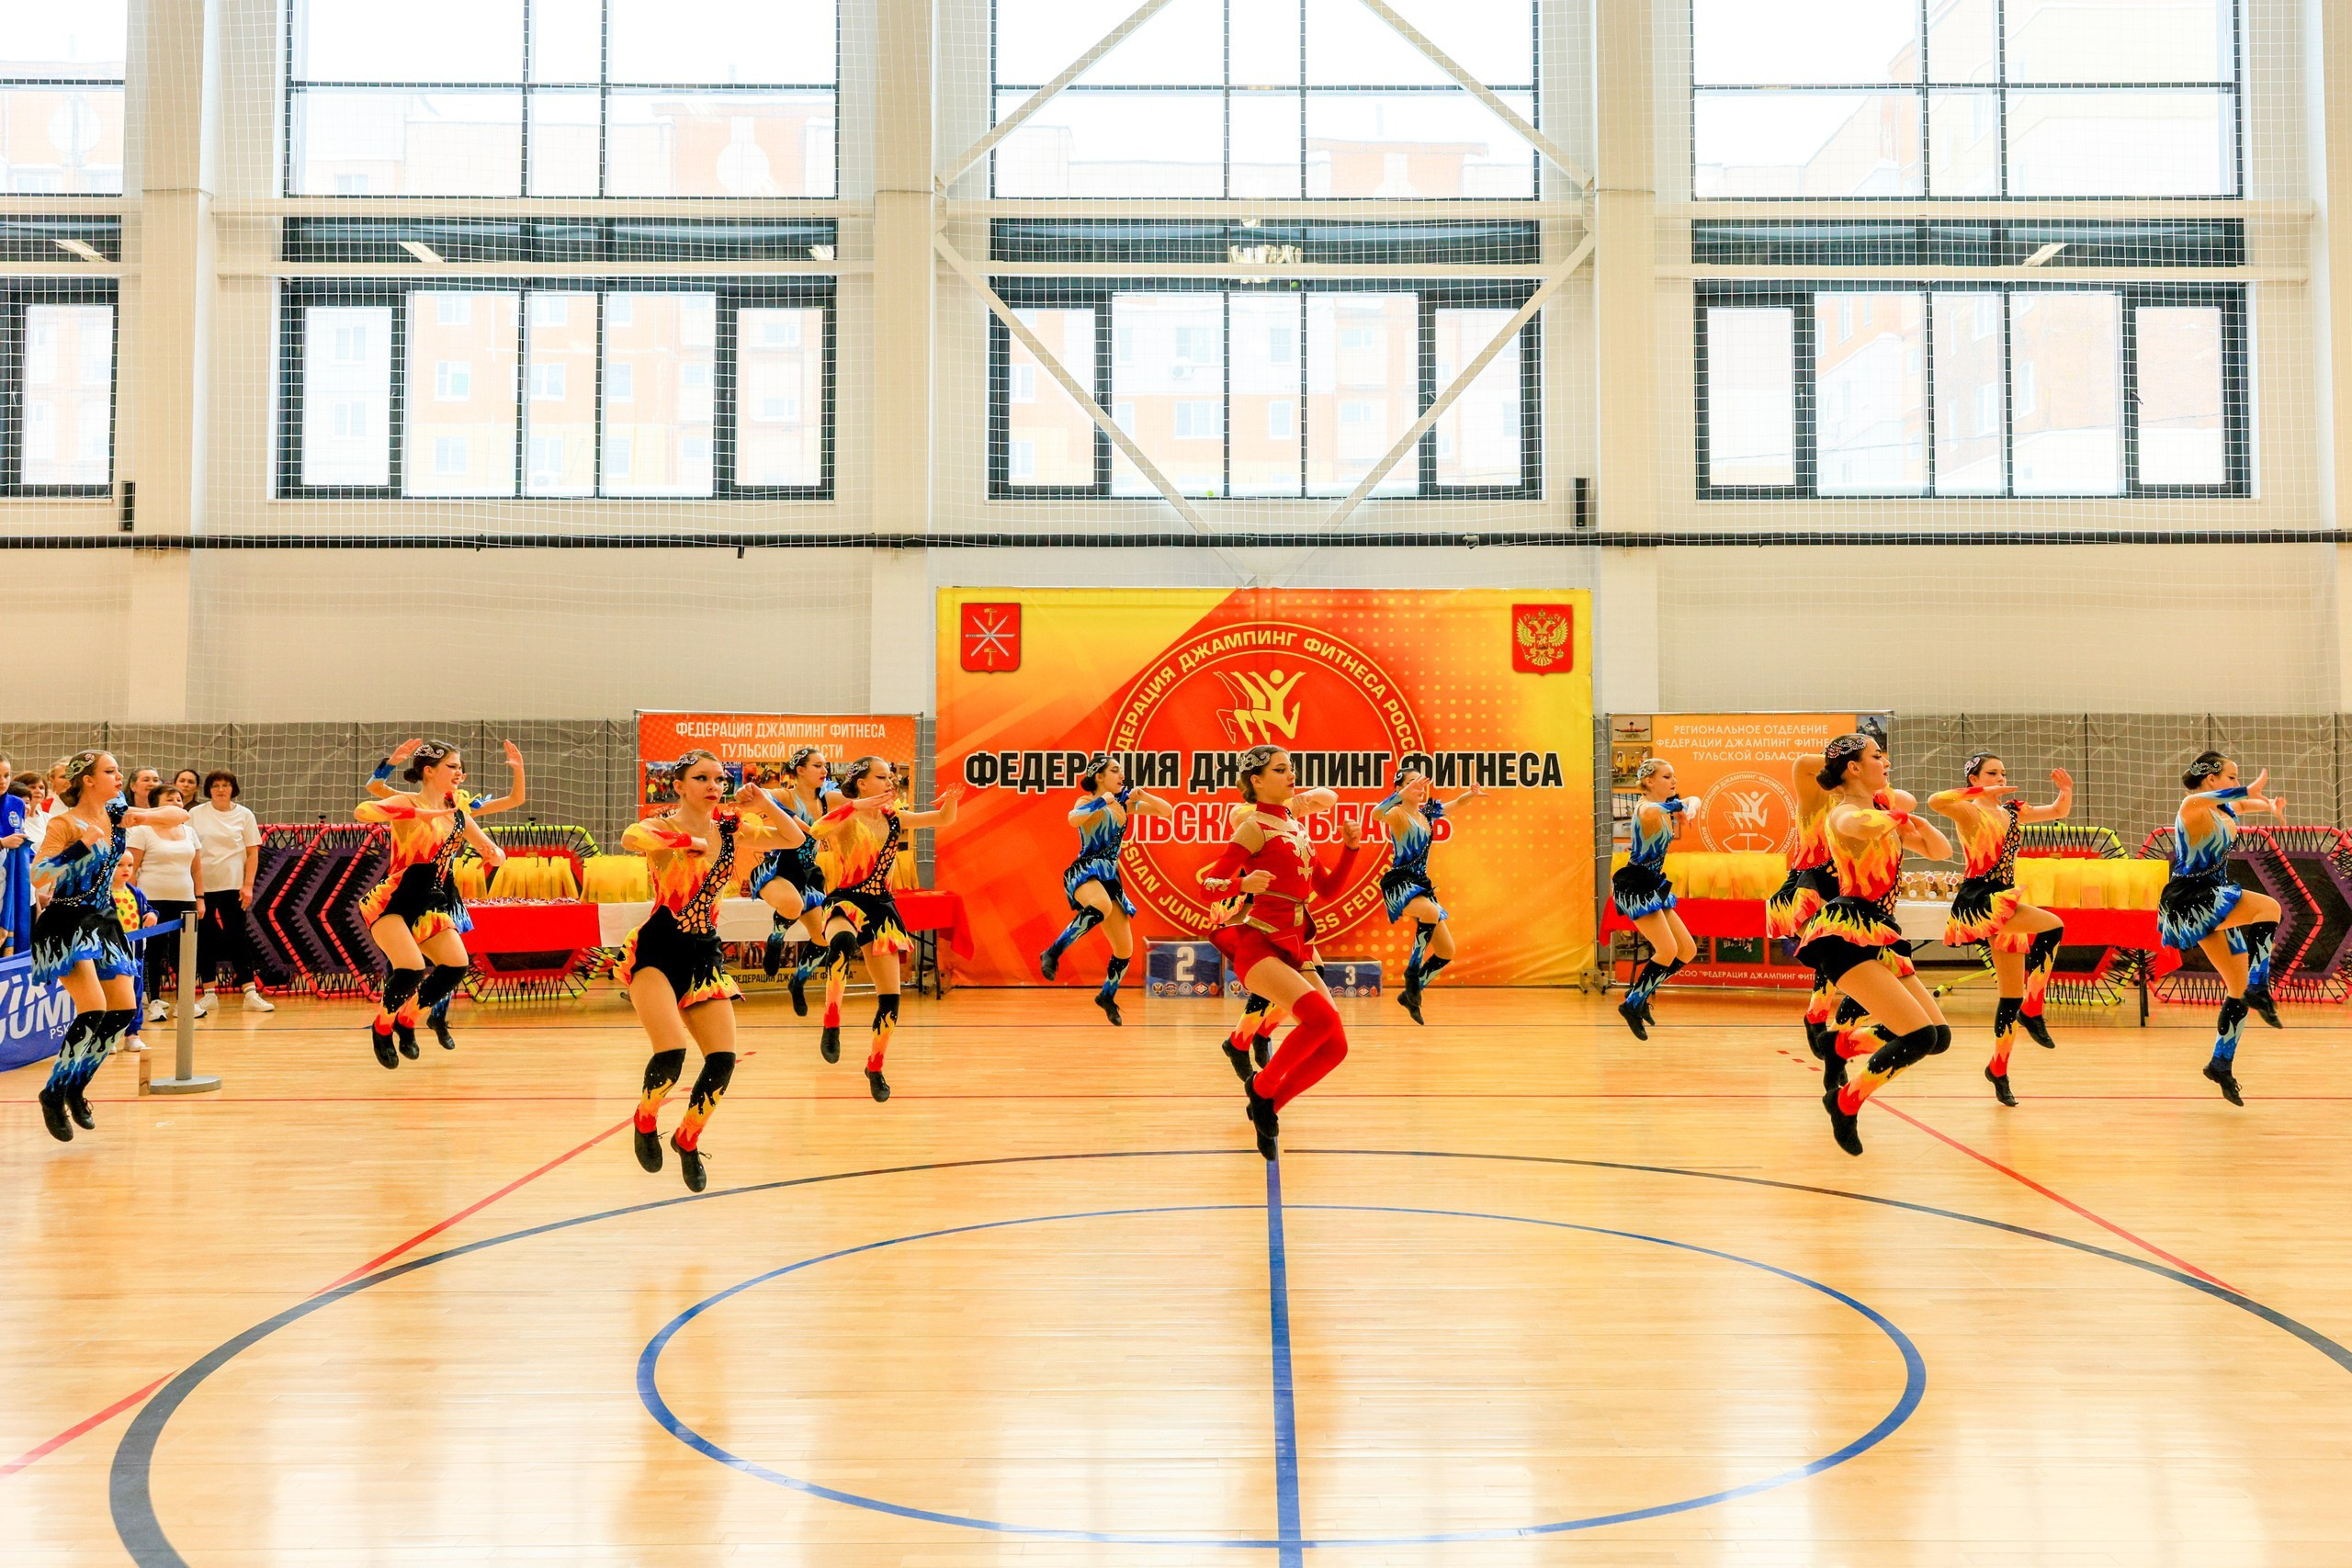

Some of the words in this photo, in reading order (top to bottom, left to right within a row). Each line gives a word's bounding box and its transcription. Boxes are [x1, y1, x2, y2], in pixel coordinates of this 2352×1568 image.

[1178, 630, 1297, 673] ДЖАМПИНГ
[1304, 637, 1386, 700] ФИТНЕСА
[1383, 698, 1417, 755] РОСС
[675, 722, 752, 738] ФЕДЕРАЦИЯ
[755, 723, 827, 739] ДЖАМПИНГ
[830, 724, 886, 739] ФИТНЕСА
[1674, 725, 1760, 735] РЕГИОНАЛЬНОЕ
[1764, 725, 1828, 736] ОТДЕЛЕНИЕ
[721, 741, 785, 759] ТУЛЬСКОЙ
[1656, 738, 1722, 749] ФЕДЕРАЦИИ
[1724, 738, 1791, 748] ДЖАМПИНГ
[1794, 738, 1834, 748] ФИТНЕ
[1693, 749, 1752, 761] ТУЛЬСКОЙ
[1756, 751, 1808, 761] ОБЛАС
[966, 750, 1180, 794] ФЕДЕРЦИЯ
[1189, 750, 1391, 794] ДЖПИНГ
[1758, 776, 1786, 795] ФИТНЕСА
[1176, 946, 1195, 982] 2
[1345, 965, 1356, 986] 3
[1749, 972, 1795, 980] ДЖАМПИНГ
